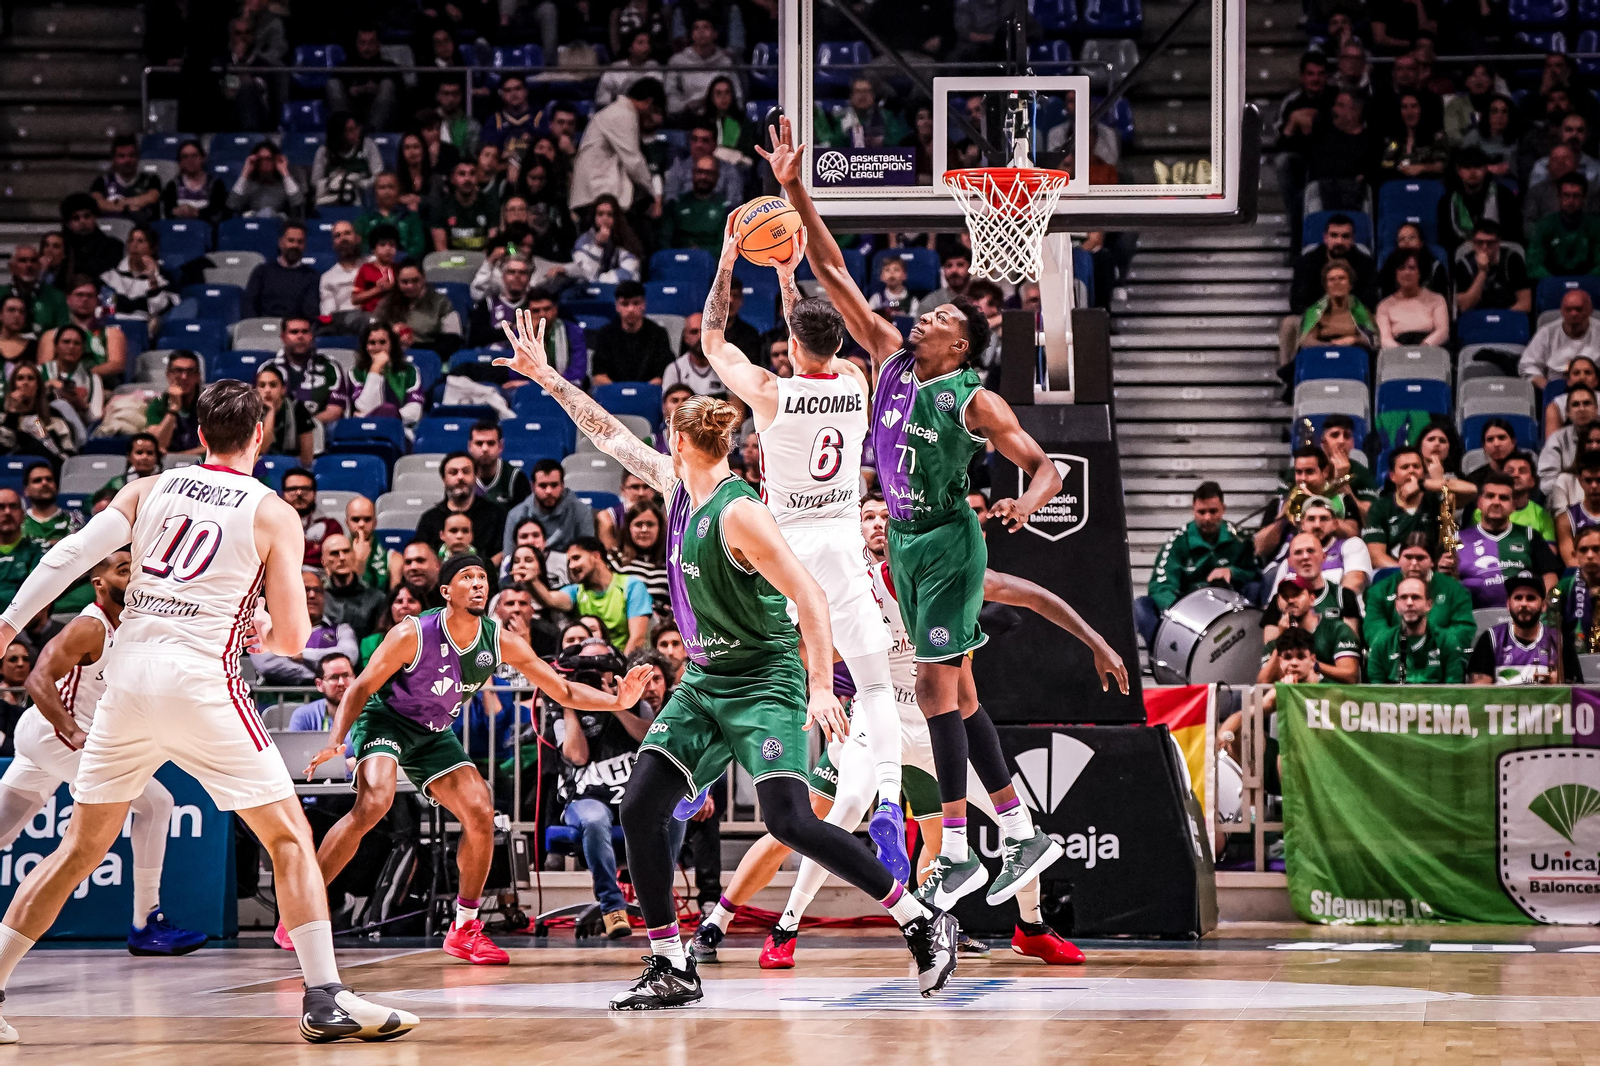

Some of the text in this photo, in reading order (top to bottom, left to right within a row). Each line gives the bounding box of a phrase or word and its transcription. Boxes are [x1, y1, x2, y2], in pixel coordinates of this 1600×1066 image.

[850, 154, 905, 162] BASKETBALL
[850, 162, 912, 171] CHAMPIONS
[850, 171, 884, 179] LEAGUE
[743, 200, 787, 225] Wilson
[772, 227, 787, 239] FIBA
[784, 393, 863, 415] LACOMBE
[809, 427, 844, 482] 6
[895, 444, 916, 475] 77
[1048, 494, 1078, 504] ación
[1030, 514, 1078, 523] Baloncesto
[141, 514, 222, 583] 10
[1305, 698, 1595, 738] EL CARPENA, TEMPLO
[1310, 889, 1407, 921] Siempre
